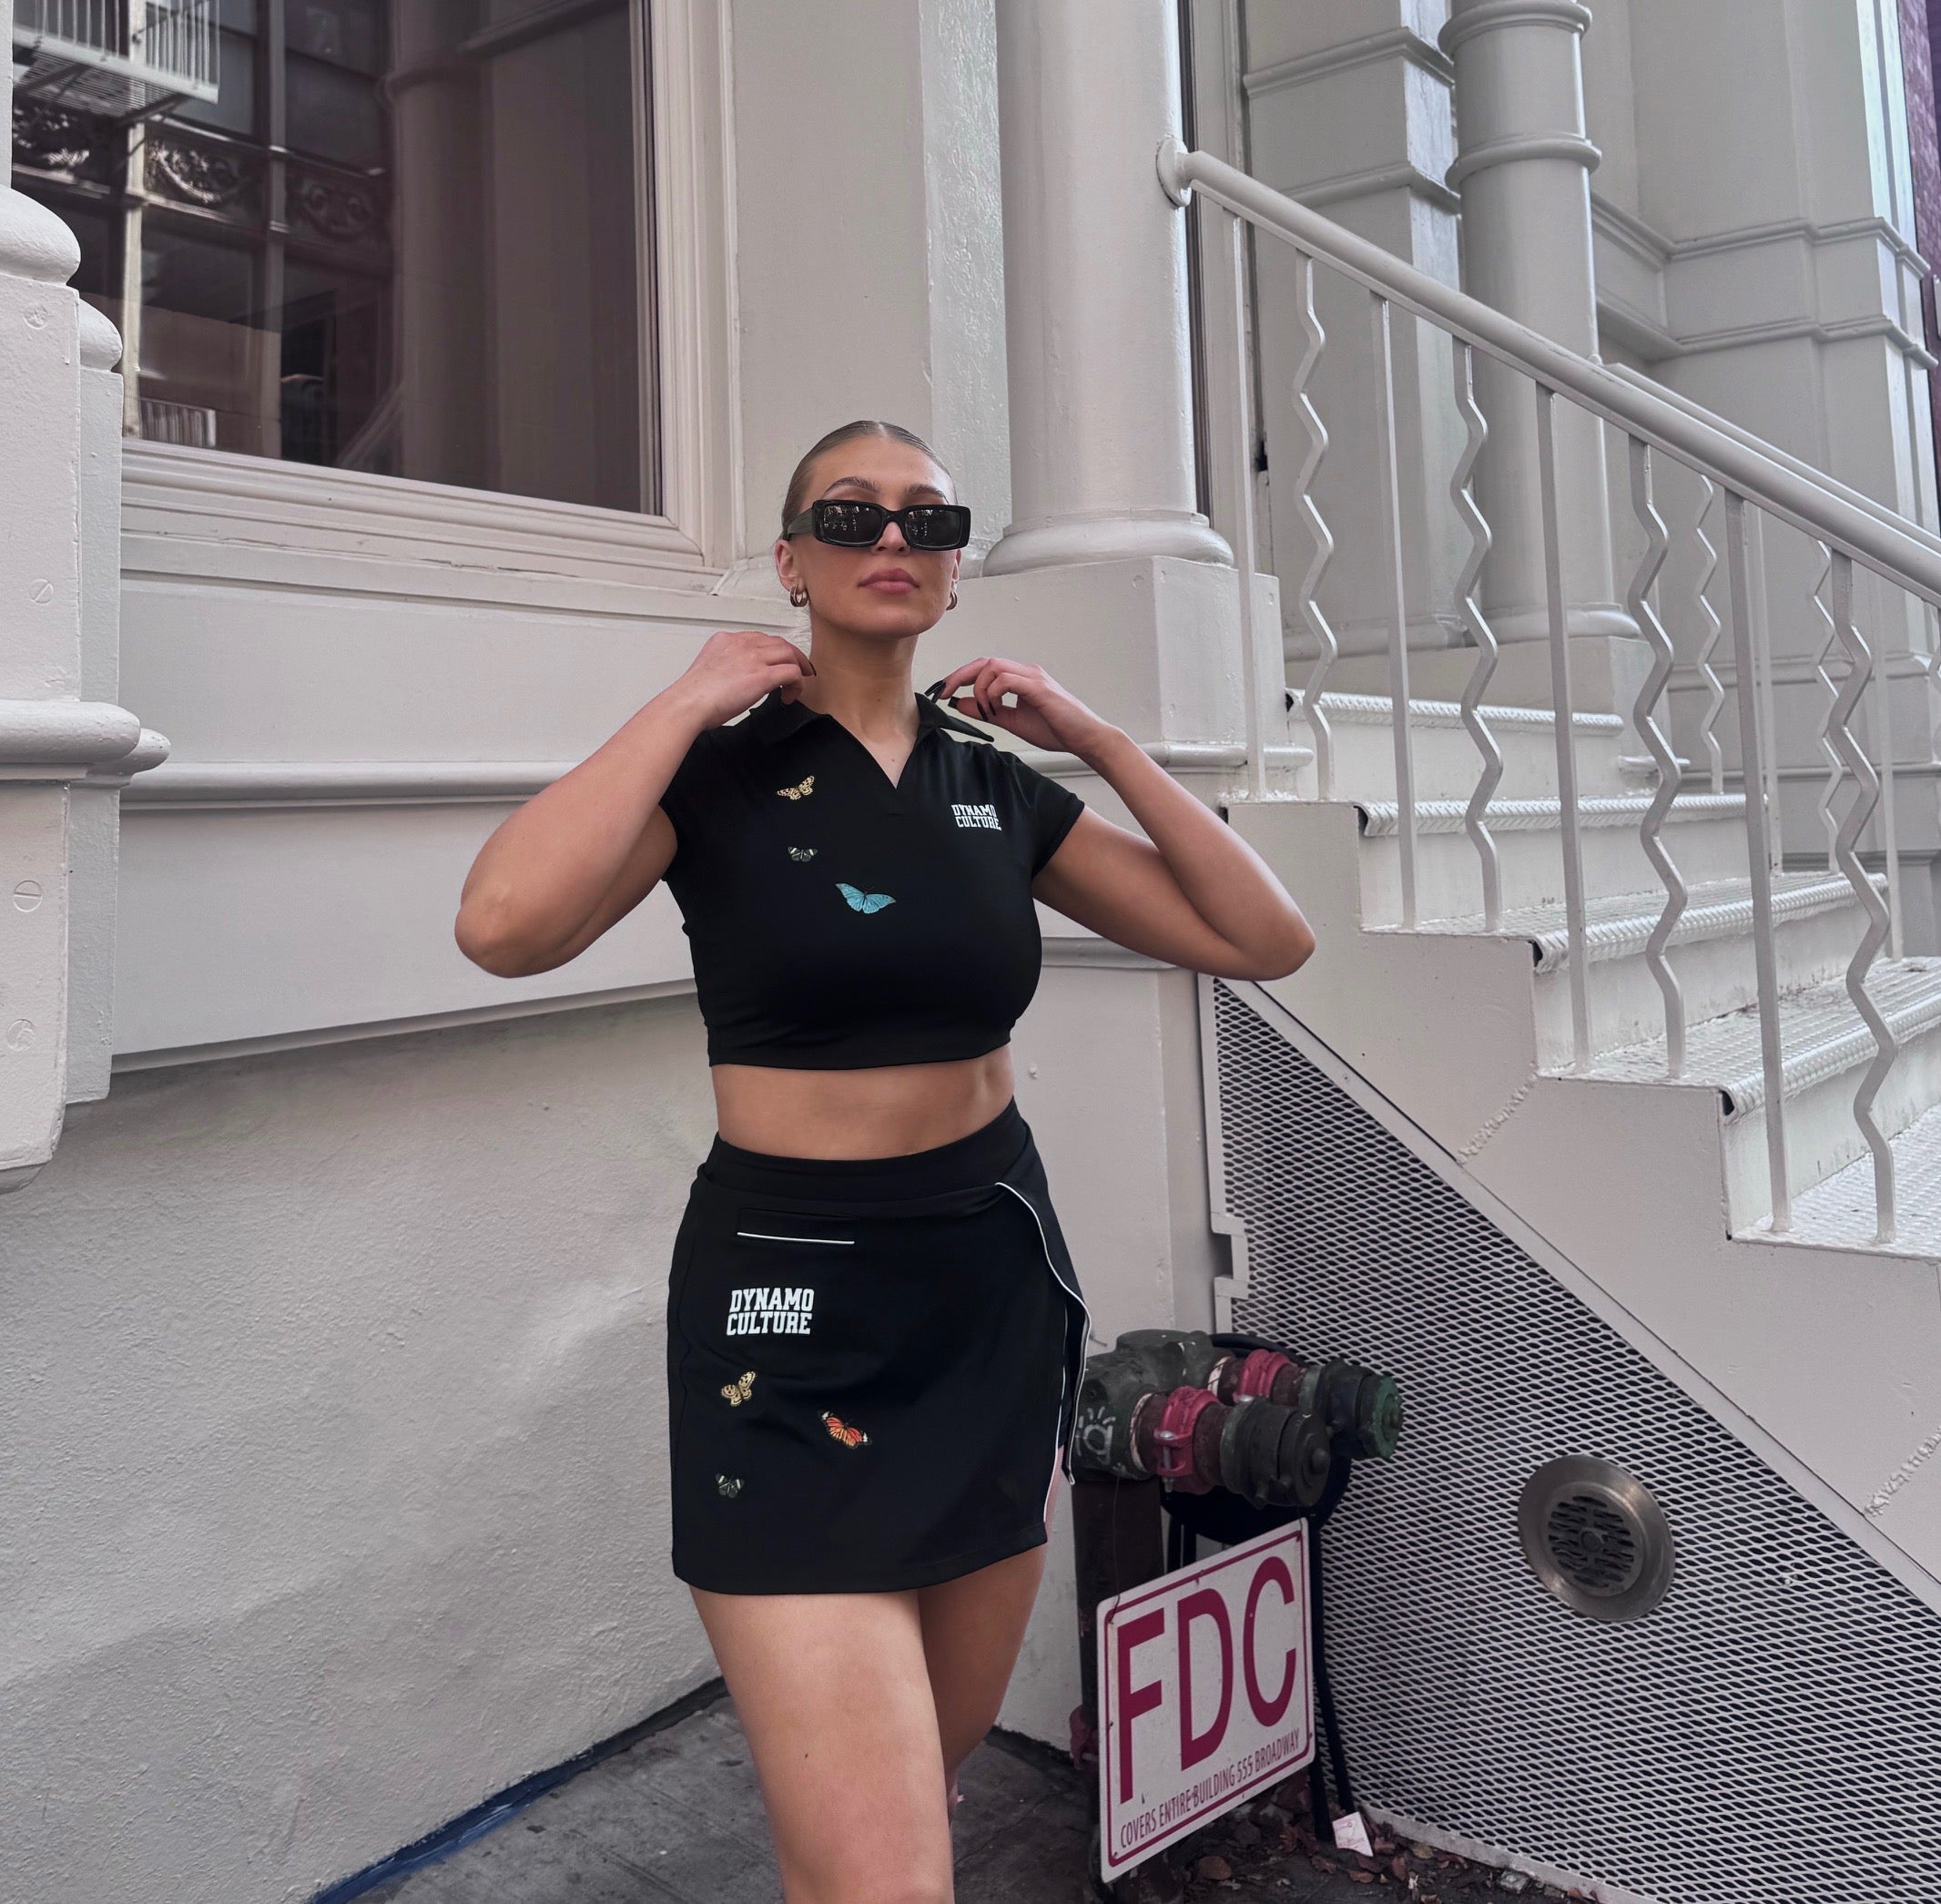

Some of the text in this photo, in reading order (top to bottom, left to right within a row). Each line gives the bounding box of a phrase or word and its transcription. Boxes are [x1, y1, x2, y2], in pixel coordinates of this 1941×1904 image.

[951, 804, 997, 818] DYNAMO
[955, 816, 1002, 830] CULTURE
[729, 1288, 815, 1313] DYNAMO
[727, 1311, 812, 1336] CULTURE
[1117, 1556, 1296, 1805] FDC
[1120, 1728, 1299, 1848] COVERS ENTIRE BUILDING 555 BROADWAY
